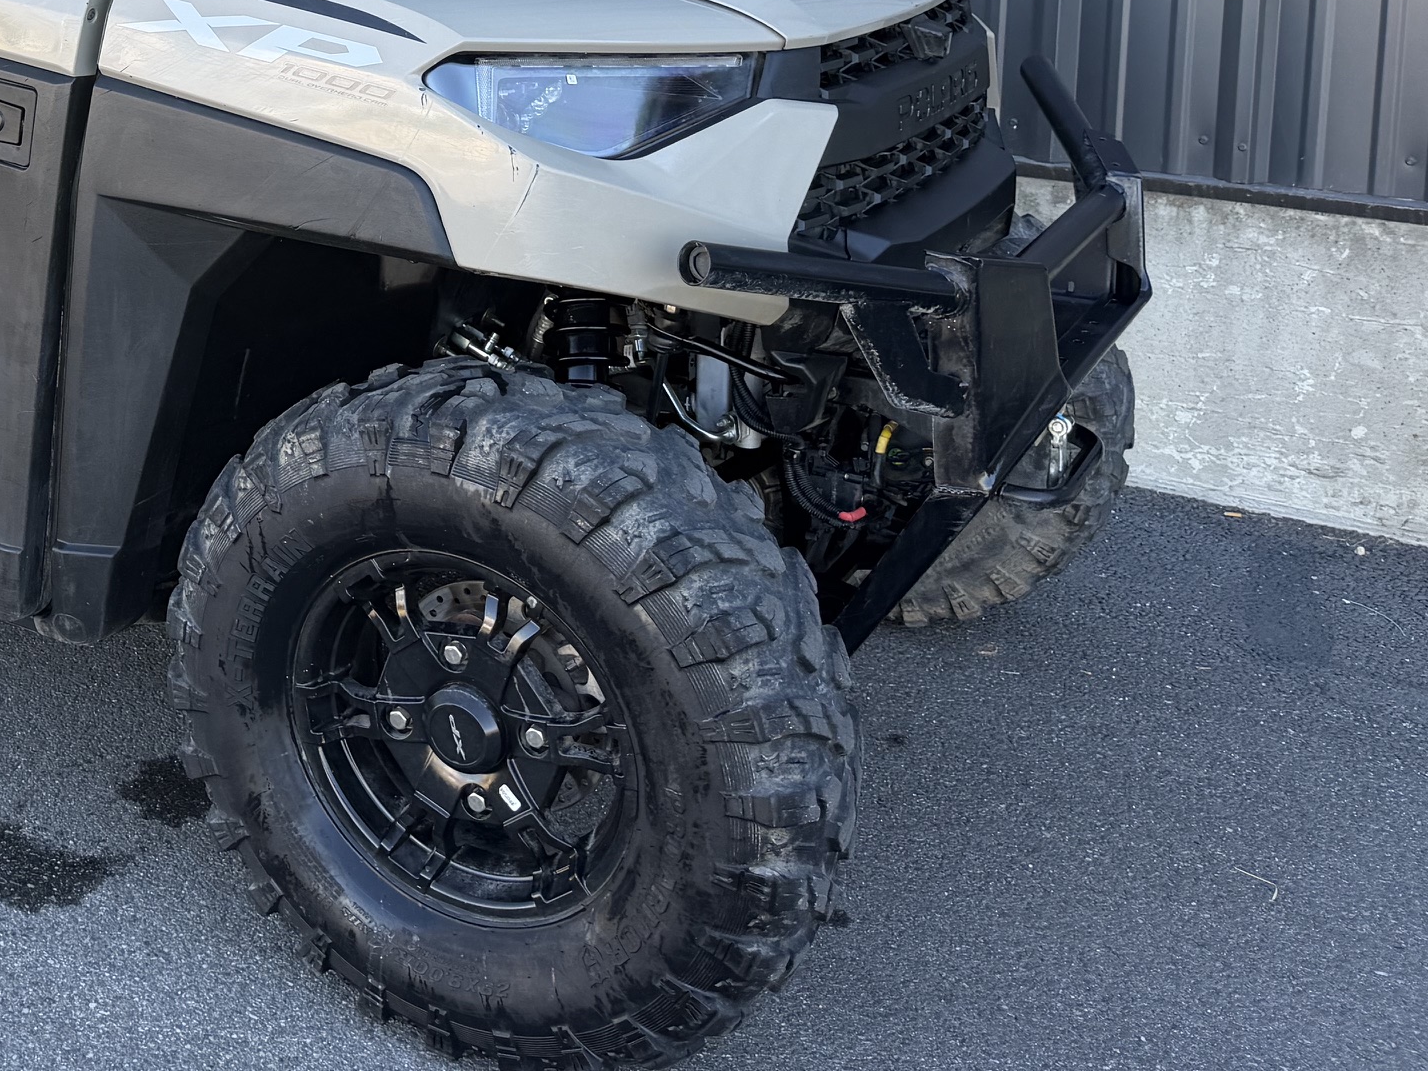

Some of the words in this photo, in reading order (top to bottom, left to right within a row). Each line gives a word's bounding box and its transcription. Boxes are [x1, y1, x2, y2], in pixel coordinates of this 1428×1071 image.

[276, 74, 305, 88] DUAL
[305, 81, 362, 102] OVERHEAD
[361, 97, 389, 107] CAM
[280, 61, 397, 100] 1000
[896, 61, 979, 132] POLARIS
[226, 529, 315, 709] X-TERRAIN
[448, 714, 466, 761] XP
